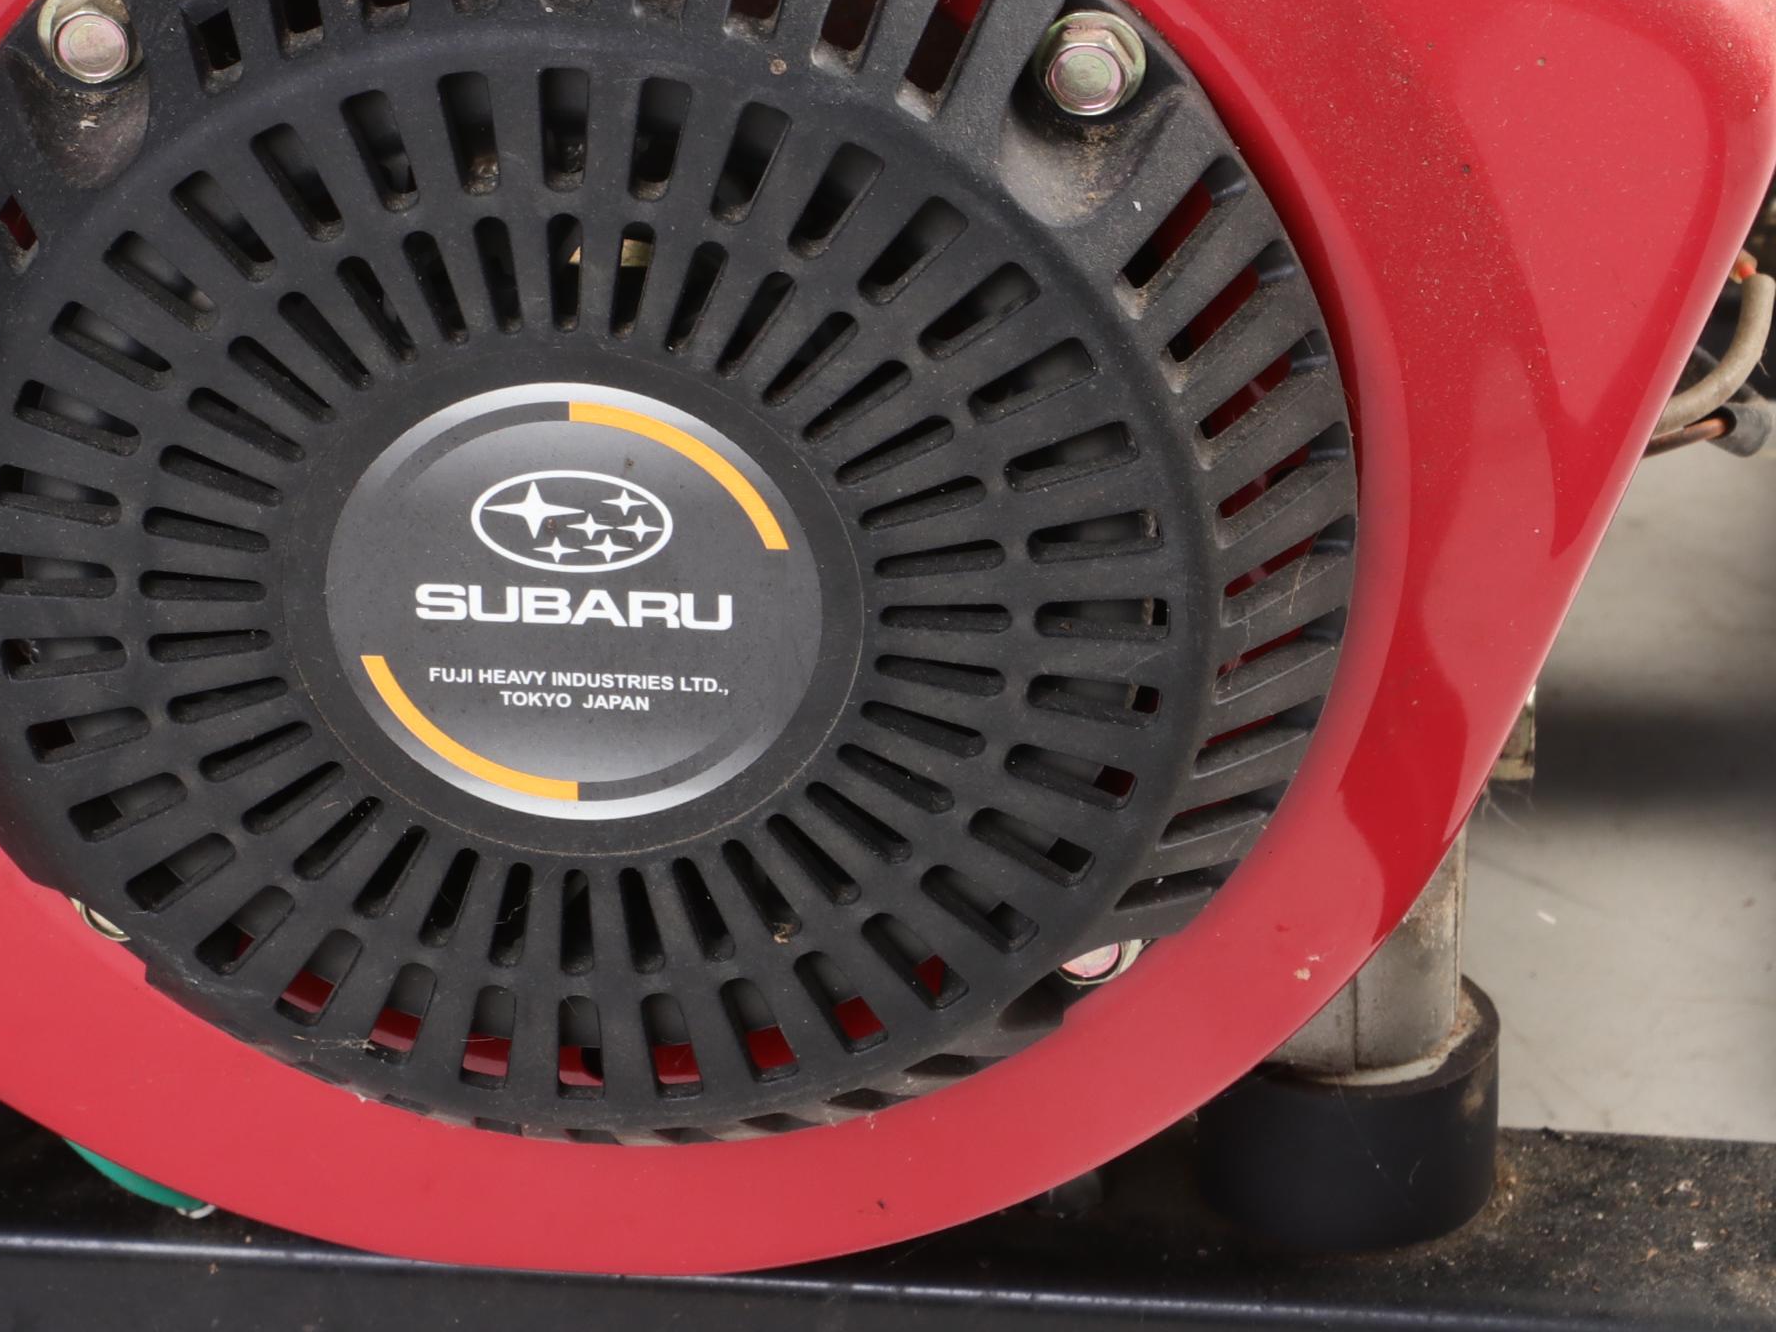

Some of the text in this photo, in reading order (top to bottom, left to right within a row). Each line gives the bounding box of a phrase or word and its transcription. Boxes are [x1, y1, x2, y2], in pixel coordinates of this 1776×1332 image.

[415, 583, 733, 631] SUBARU
[428, 667, 729, 696] FUJI HEAVY INDUSTRIES LTD.,
[499, 690, 650, 711] TOKYO JAPAN
